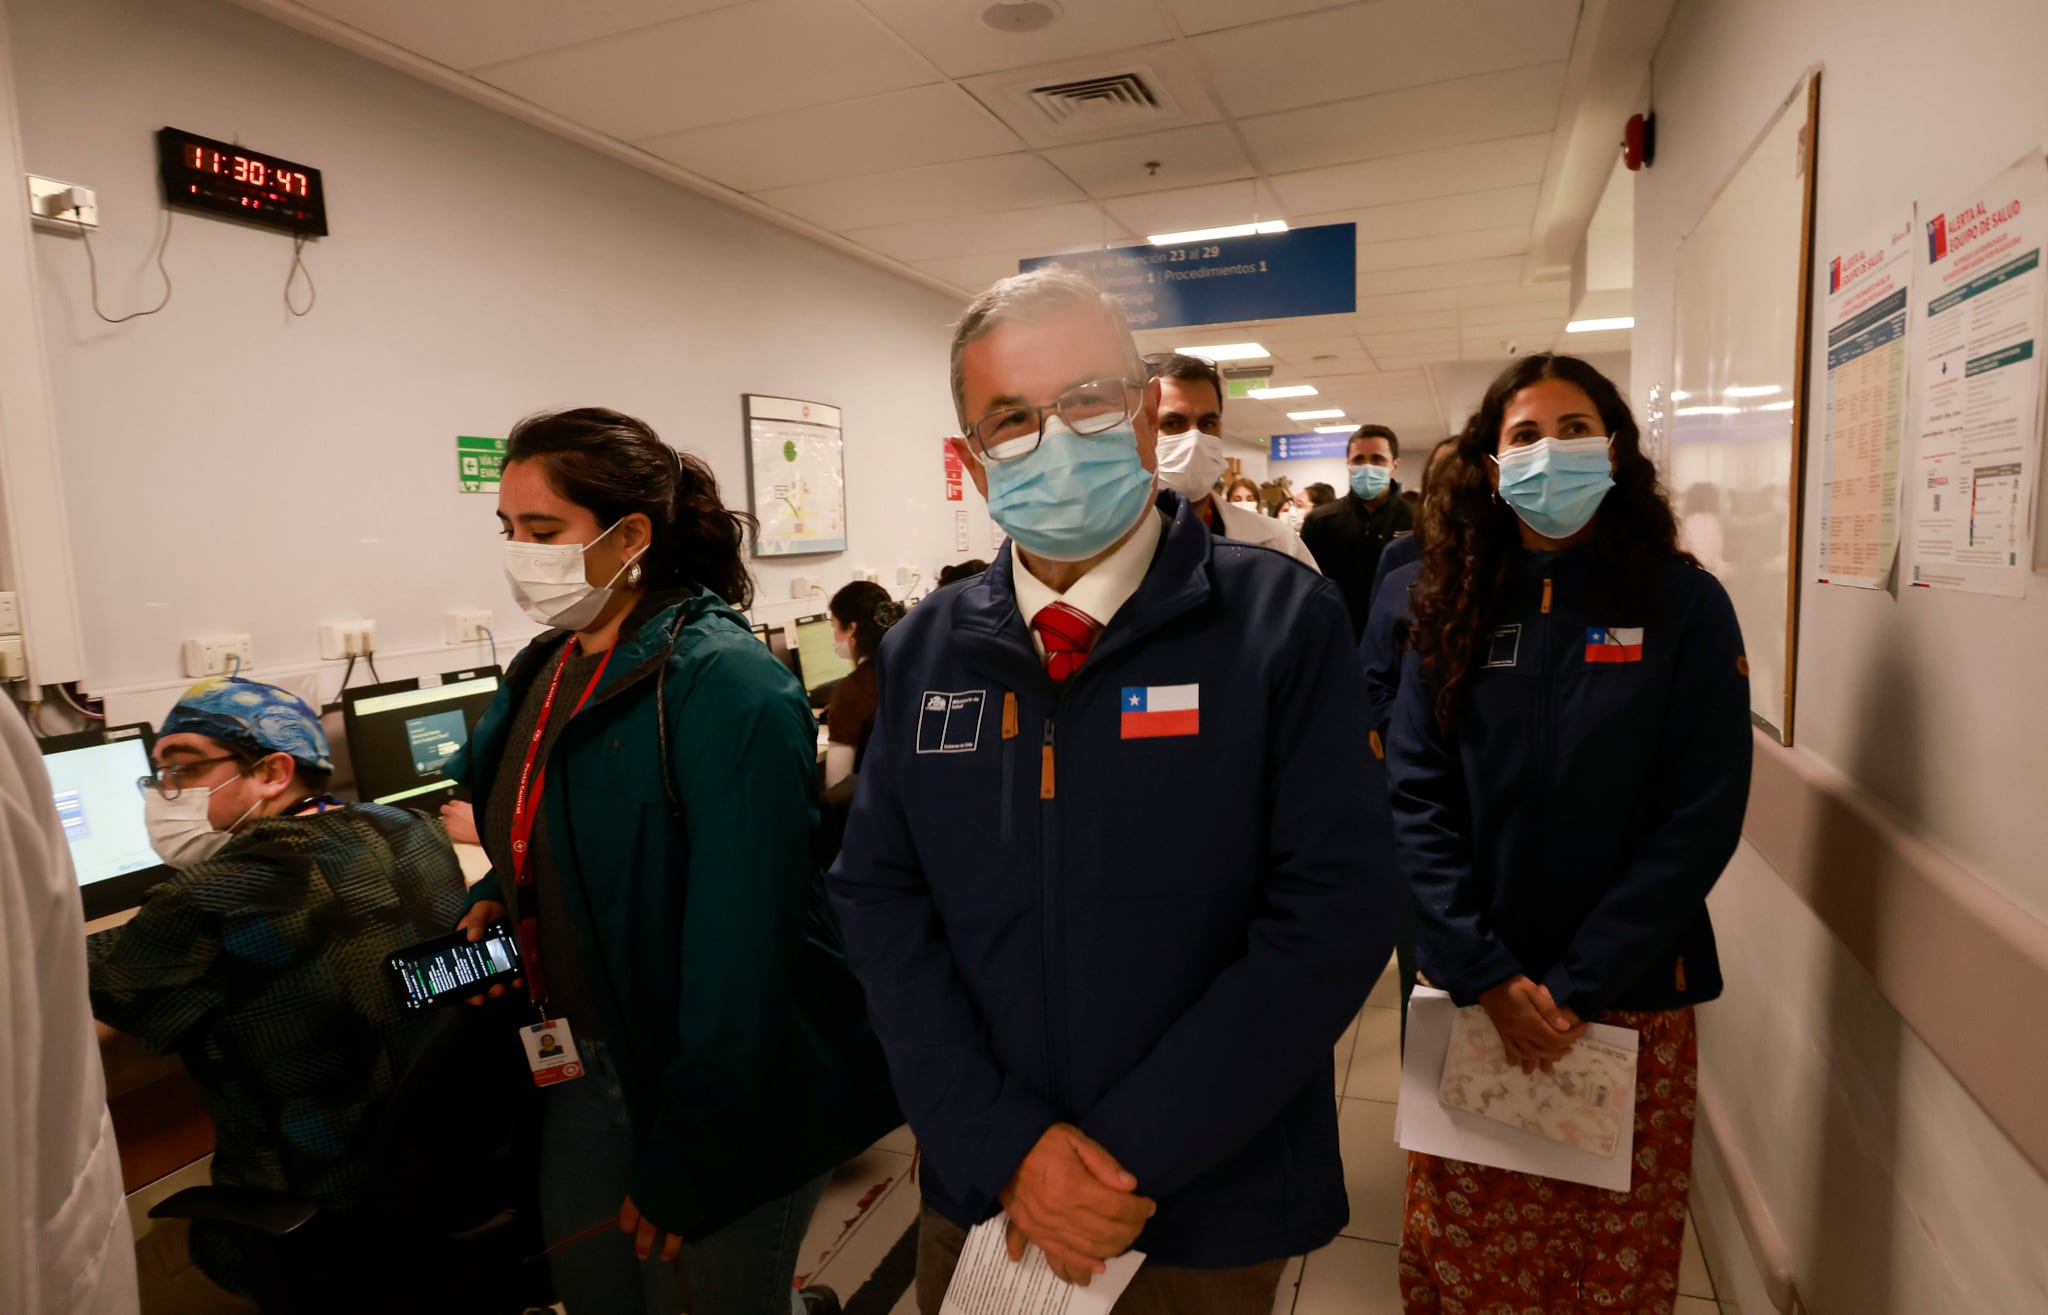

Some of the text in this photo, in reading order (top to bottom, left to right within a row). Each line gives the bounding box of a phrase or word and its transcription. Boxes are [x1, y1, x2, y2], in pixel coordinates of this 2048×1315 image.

[195, 147, 307, 196] 11:30:47
[1948, 200, 1987, 233] ALERTA AL
[1949, 224, 1979, 253] EQUIPO
[1979, 216, 1991, 235] DE
[1991, 199, 2021, 228] SALUD
[1146, 272, 1155, 284] 1
[1164, 263, 1256, 281] Procedimientos
[1259, 260, 1268, 273] 1
[1169, 249, 1186, 262] 23
[1202, 246, 1220, 259] 29
[515, 763, 530, 814] Posta Central
